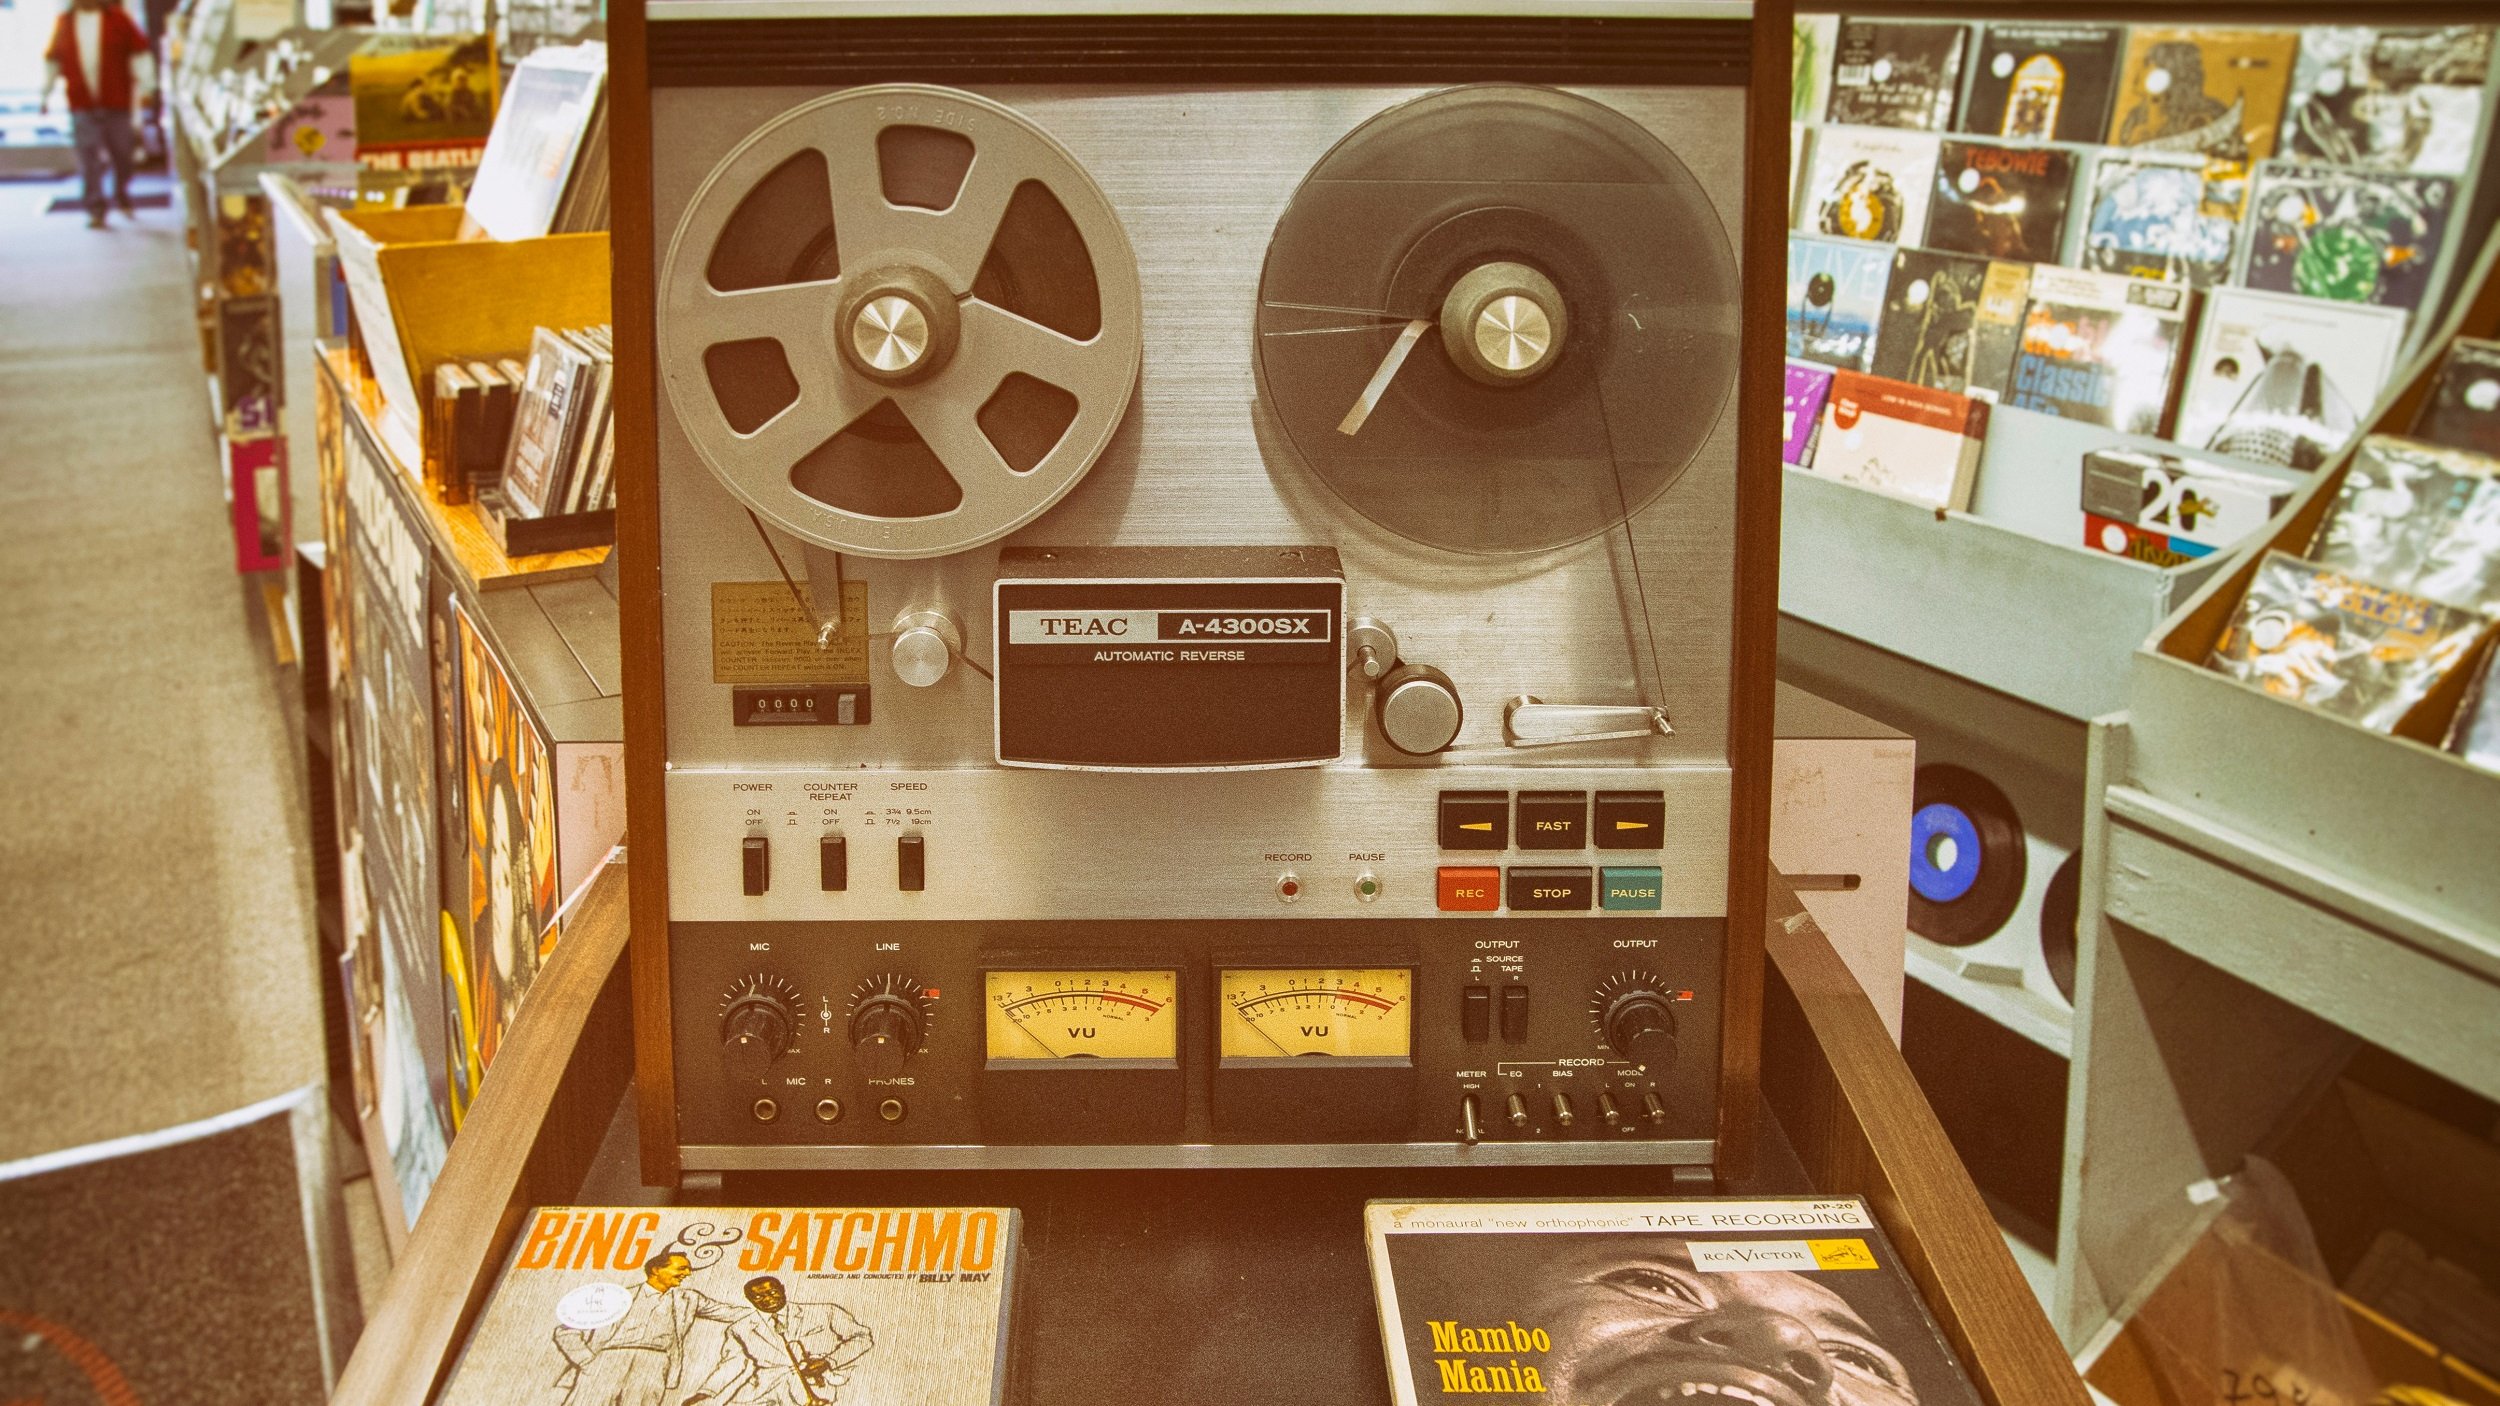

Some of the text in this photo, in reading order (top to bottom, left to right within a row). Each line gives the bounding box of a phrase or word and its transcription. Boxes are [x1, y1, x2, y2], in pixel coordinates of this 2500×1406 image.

[407, 146, 483, 169] BEATLE
[1040, 618, 1128, 636] TEAC
[1178, 618, 1311, 636] A-4300SX
[1094, 651, 1245, 661] AUTOMATIC REVERSE
[732, 784, 773, 792] POWER
[803, 783, 858, 791] COUNTER
[890, 783, 928, 791] SPEED
[809, 793, 853, 801] REPEAT
[745, 818, 763, 826] OFF
[1536, 821, 1572, 831] FAST
[1264, 853, 1312, 862] RECORD
[1348, 853, 1385, 861] PAUSE
[1455, 888, 1485, 898] REC
[1533, 888, 1572, 898] STOP
[1611, 888, 1656, 898] PAUSE
[750, 943, 770, 951] MIC
[876, 943, 900, 951] LINE
[1475, 940, 1520, 949] OUTPUT
[1613, 940, 1658, 948] OUTPUT
[1486, 955, 1524, 963] SOURCE
[1067, 1027, 1096, 1038] VU
[1301, 1026, 1329, 1037] VU
[1559, 1058, 1605, 1067] RECORD
[1813, 1203, 1853, 1211] AP-20
[1393, 1212, 1861, 1230] a monaural "new orthophonic" TAPE RECORDING
[737, 1211, 998, 1272] SATCHMO
[1703, 1252, 1736, 1261] RCA
[919, 1273, 955, 1283] BILLY
[960, 1272, 991, 1283] MAY
[1425, 1320, 1551, 1353] Mambo
[1434, 1359, 1548, 1393] Mania
